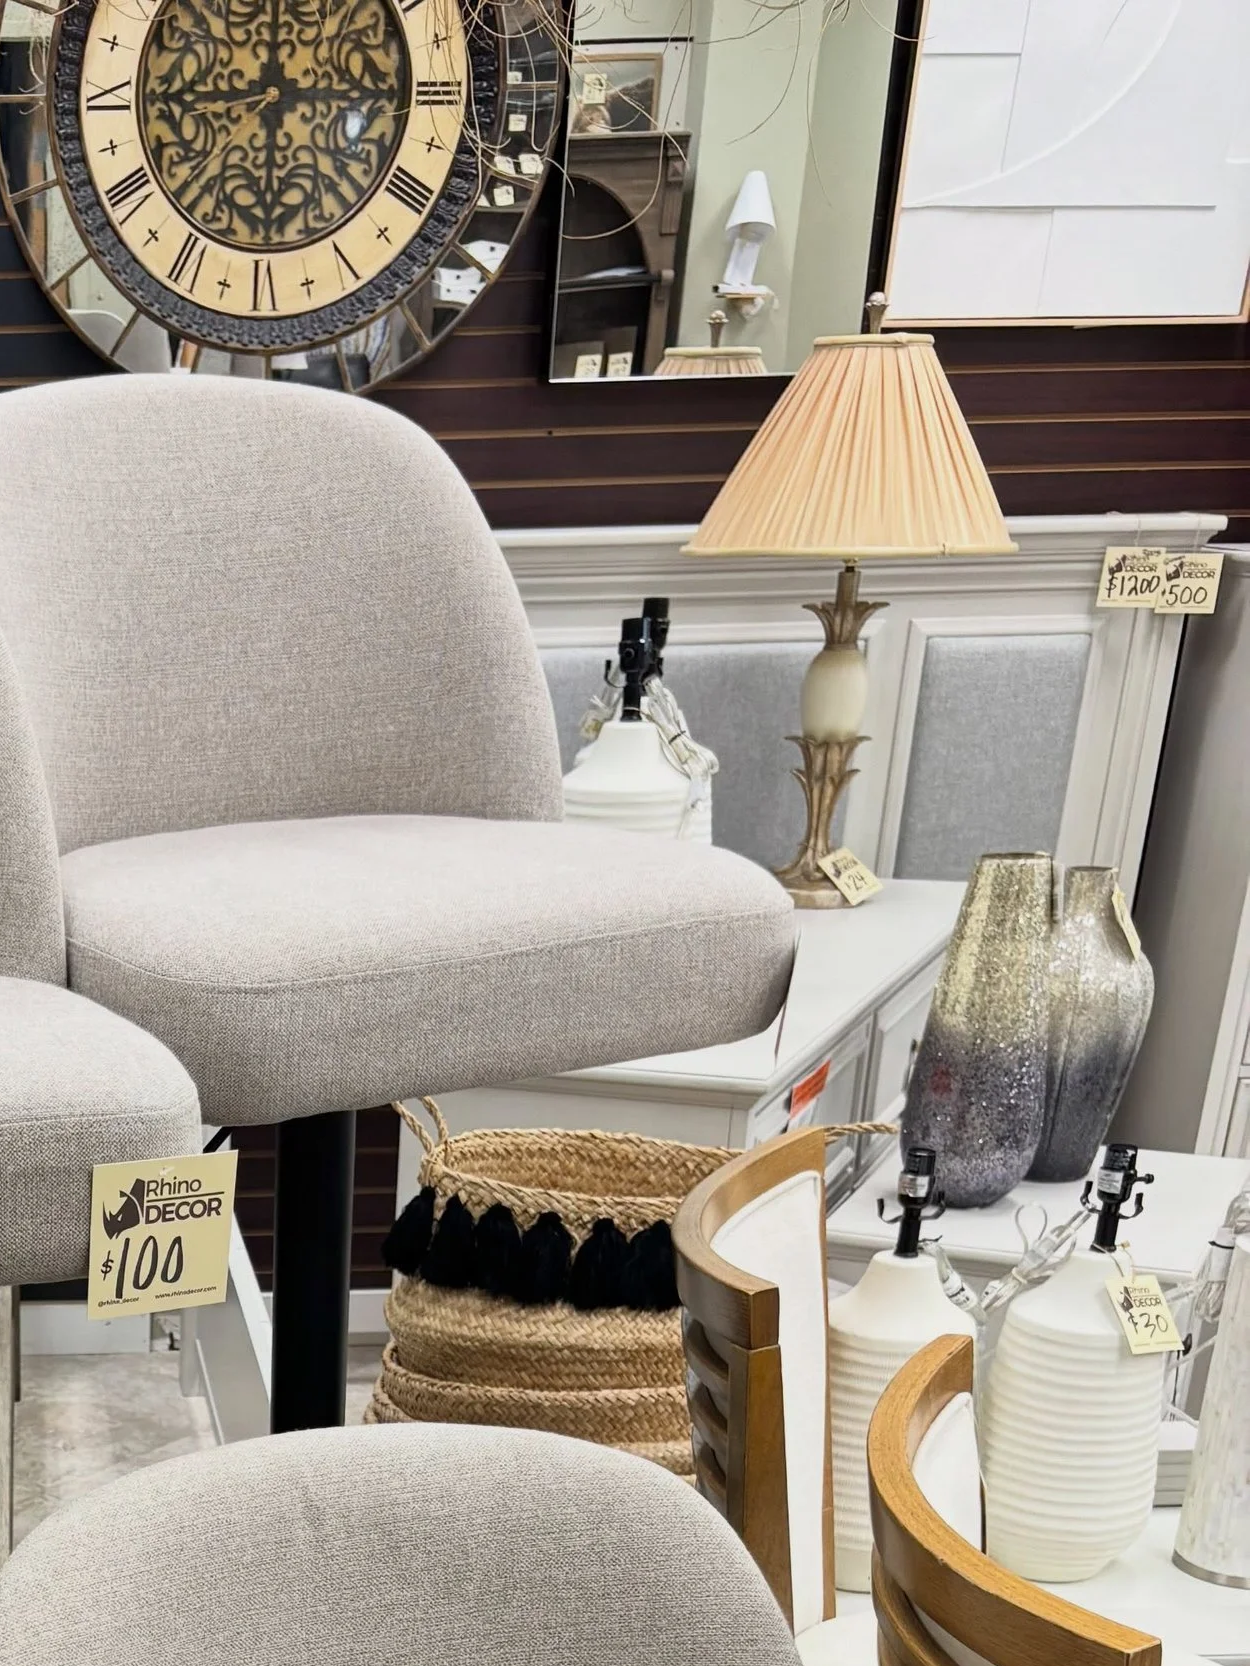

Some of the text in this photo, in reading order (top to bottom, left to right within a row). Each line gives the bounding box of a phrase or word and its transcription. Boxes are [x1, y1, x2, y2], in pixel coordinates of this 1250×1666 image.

[1182, 570, 1216, 579] DECOR
[1105, 574, 1161, 598] $1200
[145, 1176, 202, 1198] Rhino
[144, 1197, 223, 1225] DECOR
[100, 1235, 184, 1299] $100
[154, 1286, 218, 1300] www.rhinodecor.com
[1133, 1296, 1163, 1307] DECOR
